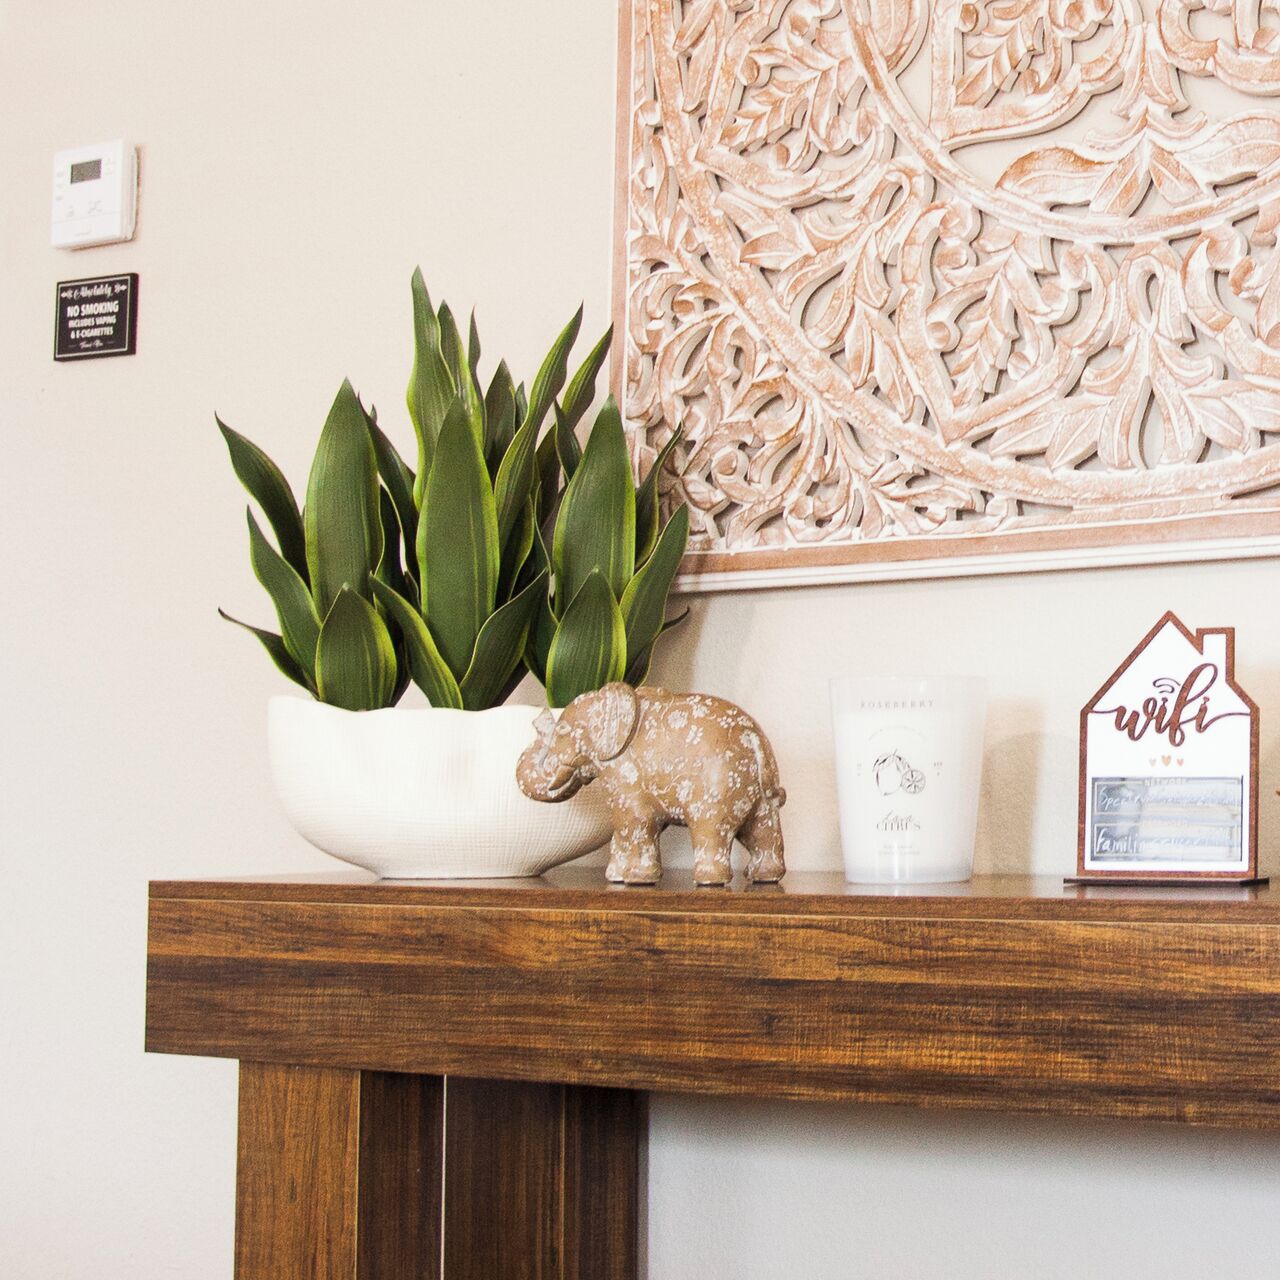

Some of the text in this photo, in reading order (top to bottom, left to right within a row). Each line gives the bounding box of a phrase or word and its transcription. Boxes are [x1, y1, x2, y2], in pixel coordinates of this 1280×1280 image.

[67, 301, 119, 318] NO SMOKING
[68, 315, 117, 328] INCLUDES VAPING
[1106, 663, 1230, 747] wifi
